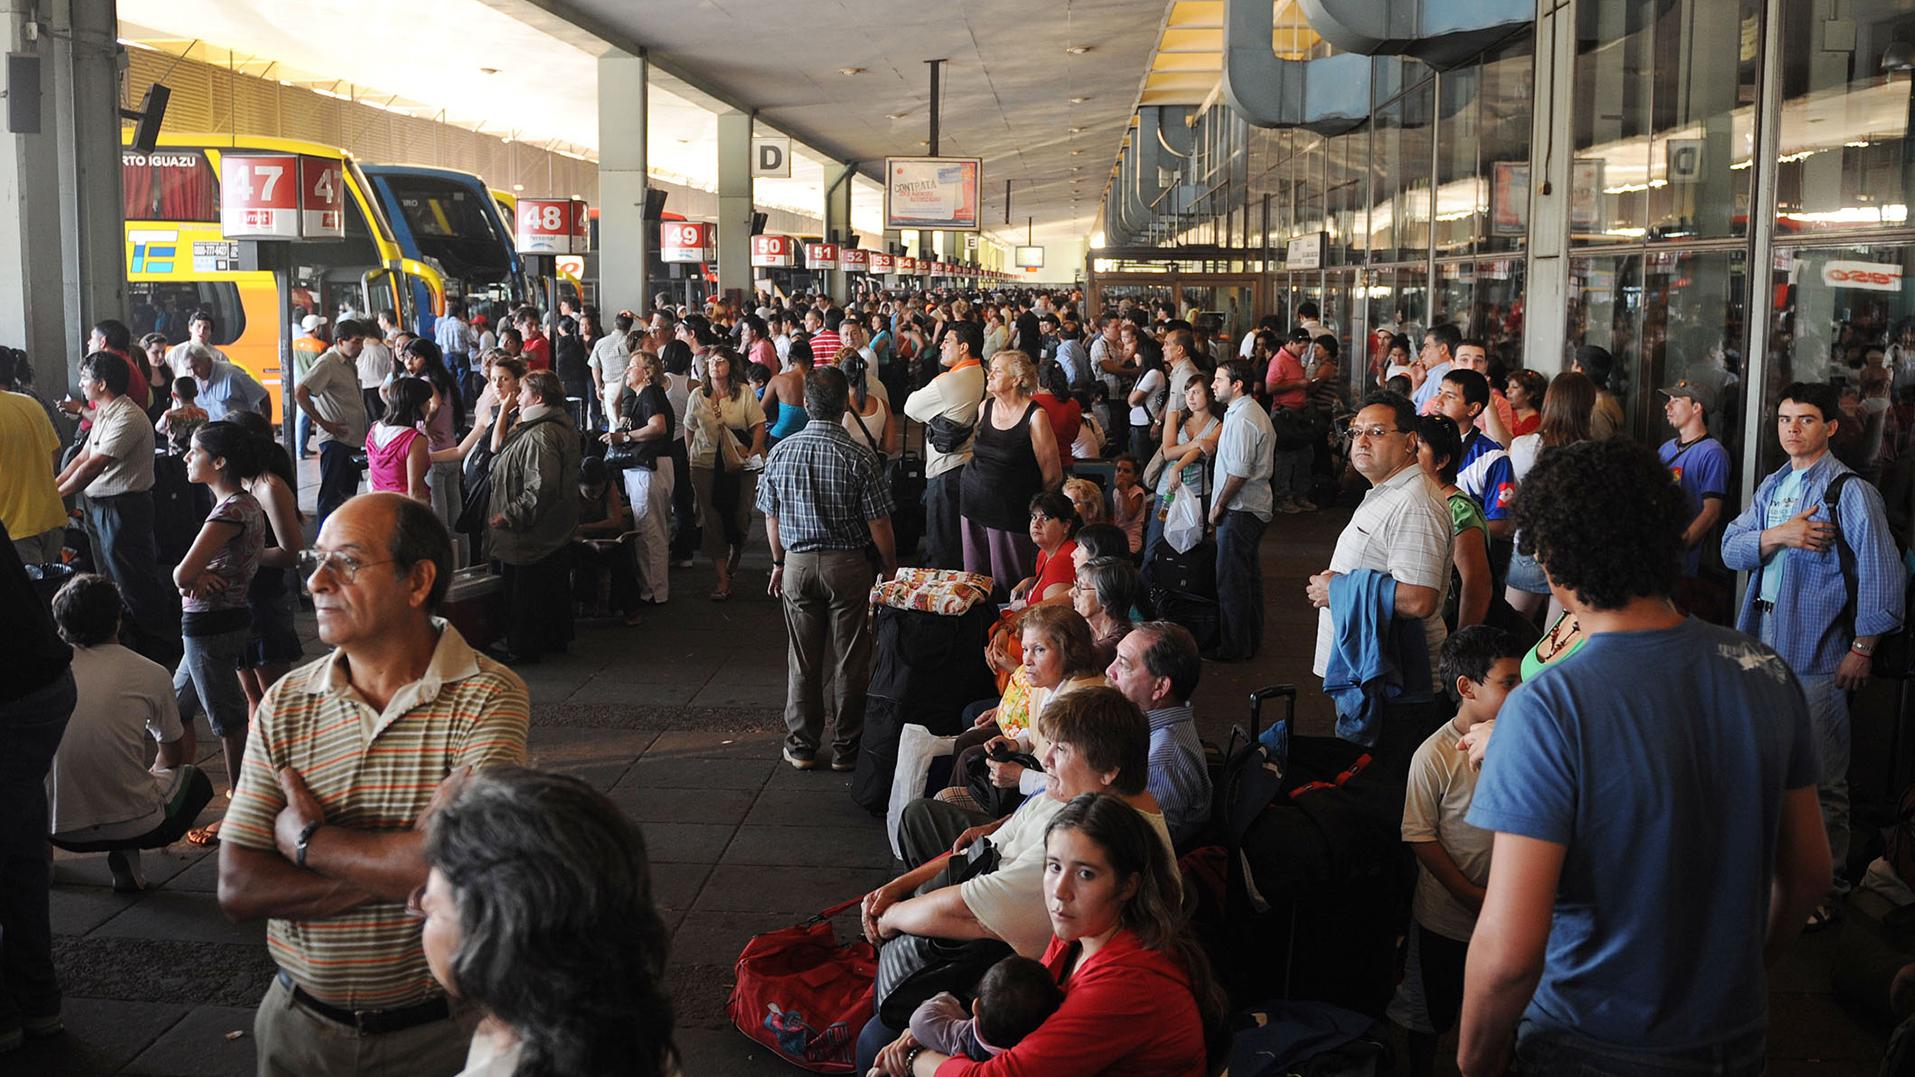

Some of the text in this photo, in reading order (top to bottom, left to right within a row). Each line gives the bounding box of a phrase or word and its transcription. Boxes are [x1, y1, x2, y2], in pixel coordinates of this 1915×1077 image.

[149, 156, 196, 167] IGUAZU
[760, 145, 782, 170] D
[234, 165, 284, 202] 47
[524, 205, 562, 231] 48
[670, 226, 698, 245] 49
[758, 239, 781, 253] 50
[968, 238, 975, 247] E
[814, 246, 831, 259] 51
[847, 251, 863, 262] 52
[875, 256, 890, 265] 53
[897, 258, 912, 268] 54
